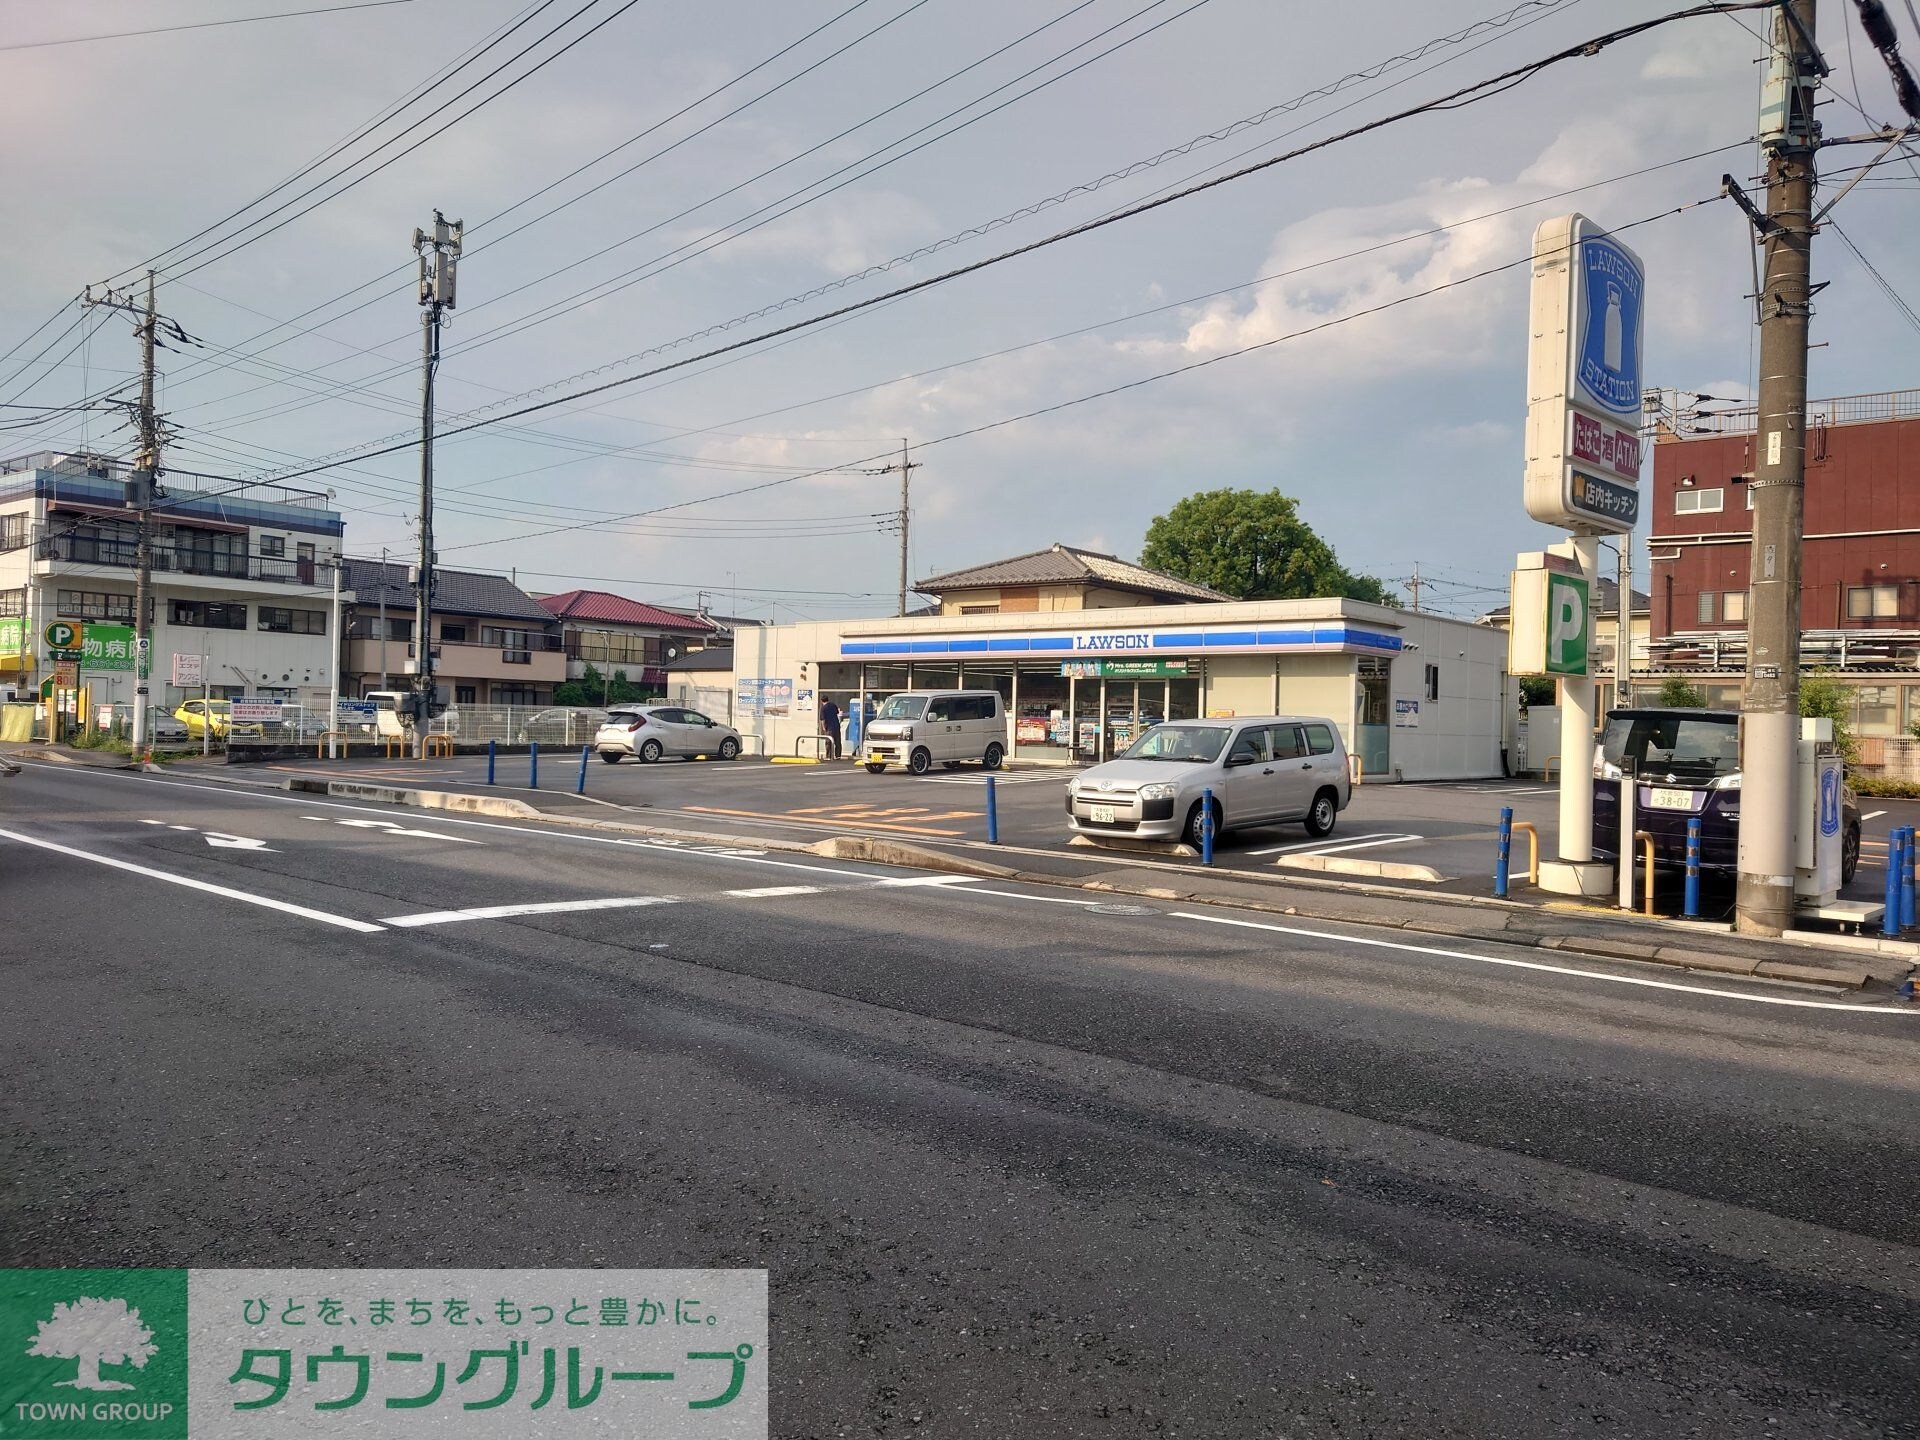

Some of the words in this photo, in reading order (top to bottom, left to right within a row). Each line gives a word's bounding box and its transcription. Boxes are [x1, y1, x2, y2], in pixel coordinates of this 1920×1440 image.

[1589, 249, 1638, 299] LAWSON
[1585, 357, 1635, 401] STATION
[1575, 421, 1600, 455] たばこ
[1616, 439, 1638, 471] ATM
[1586, 482, 1637, 516] 店内キッチン
[55, 626, 71, 644] P
[1076, 634, 1149, 650] LAWSON
[1550, 582, 1583, 664] P
[1659, 795, 1691, 808] 38-07
